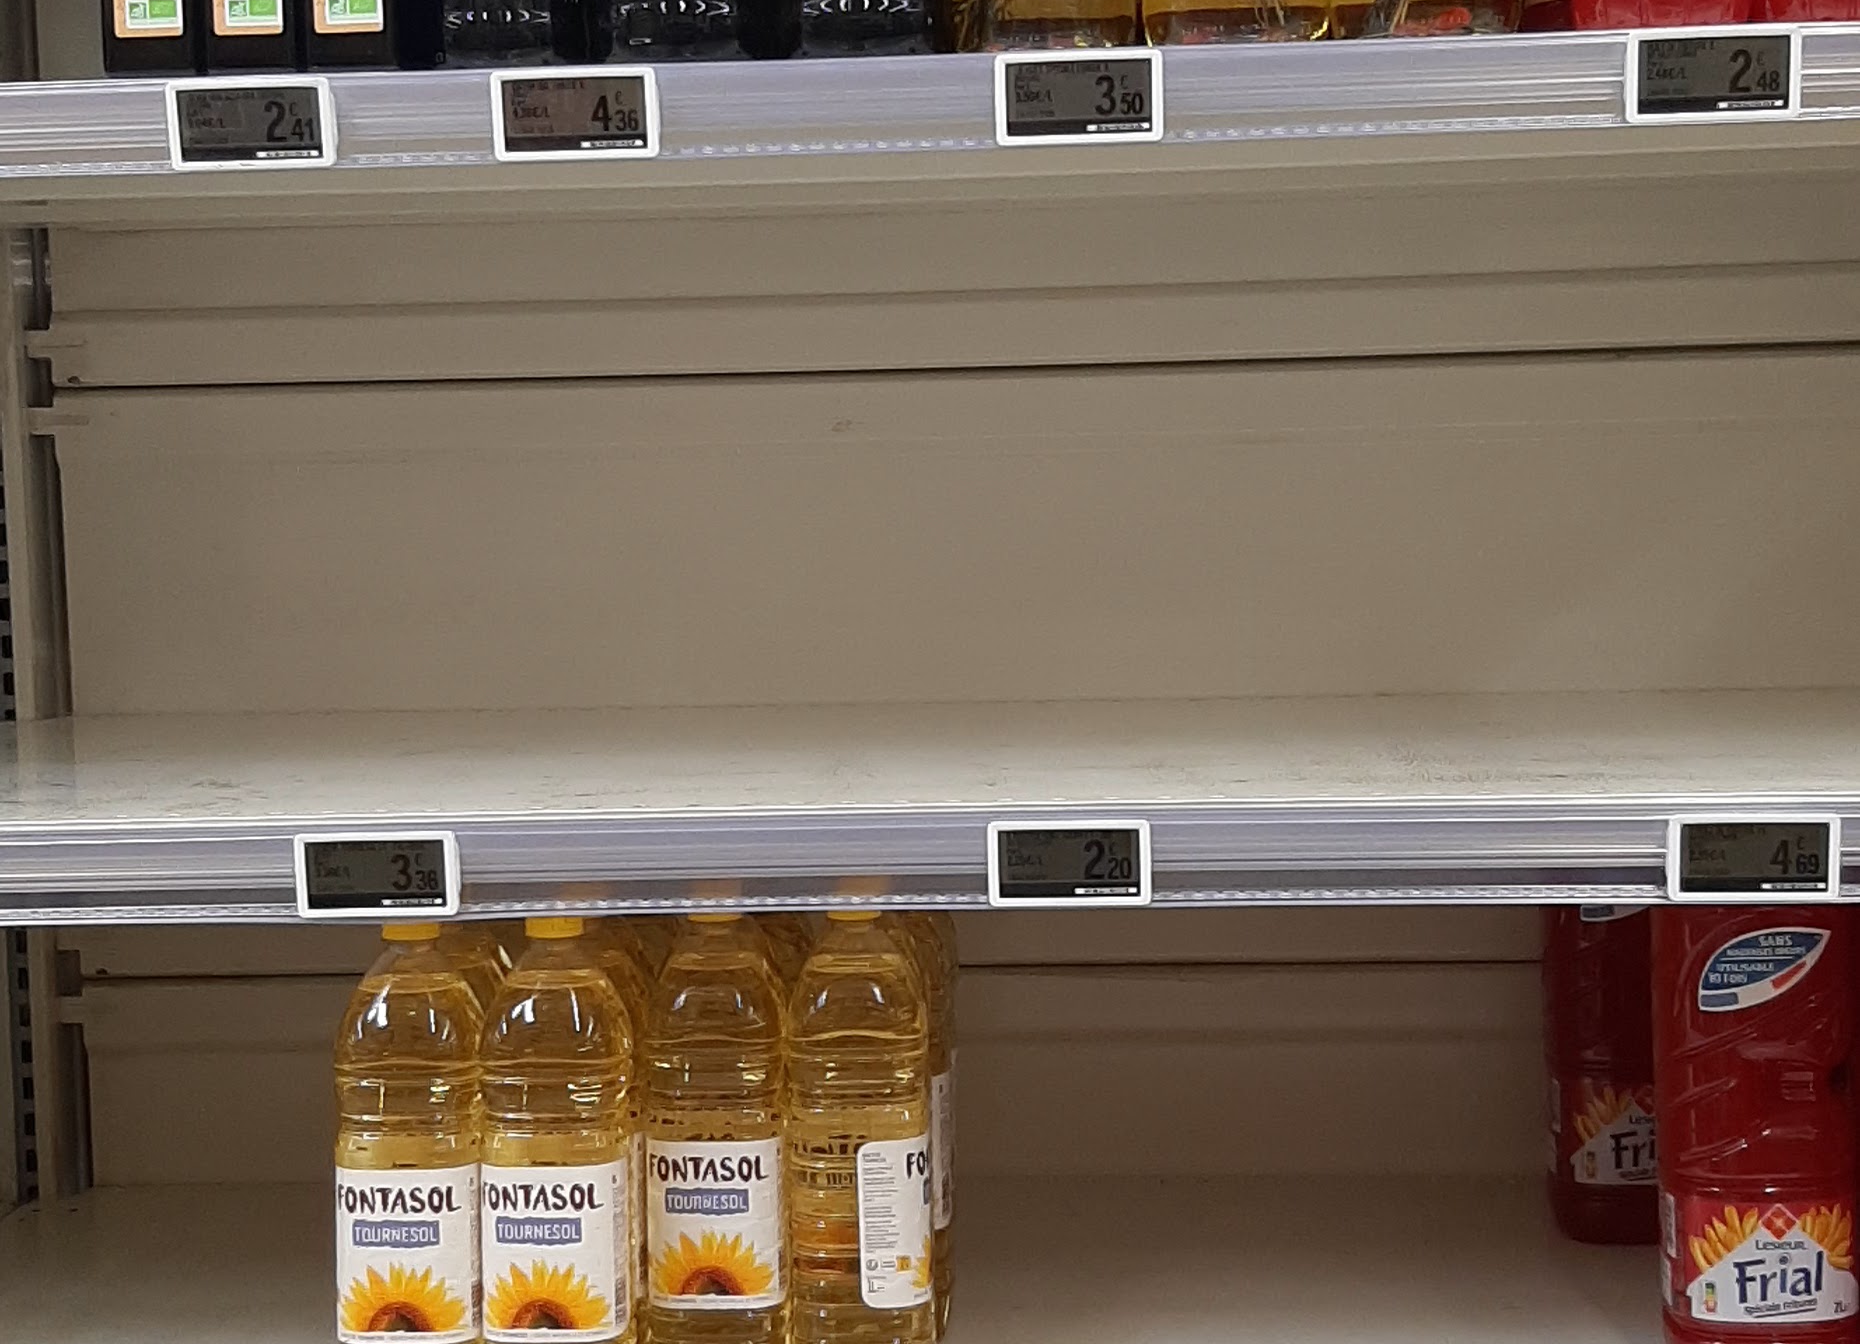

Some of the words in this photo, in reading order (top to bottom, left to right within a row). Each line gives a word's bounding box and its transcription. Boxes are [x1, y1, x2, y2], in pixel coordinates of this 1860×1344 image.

[649, 1152, 770, 1184] FONTASOL
[337, 1183, 462, 1214] FONTASOL
[354, 1226, 437, 1243] TOURNESOL
[497, 1222, 581, 1240] TOURNESOL
[1733, 1250, 1825, 1305] Frial
